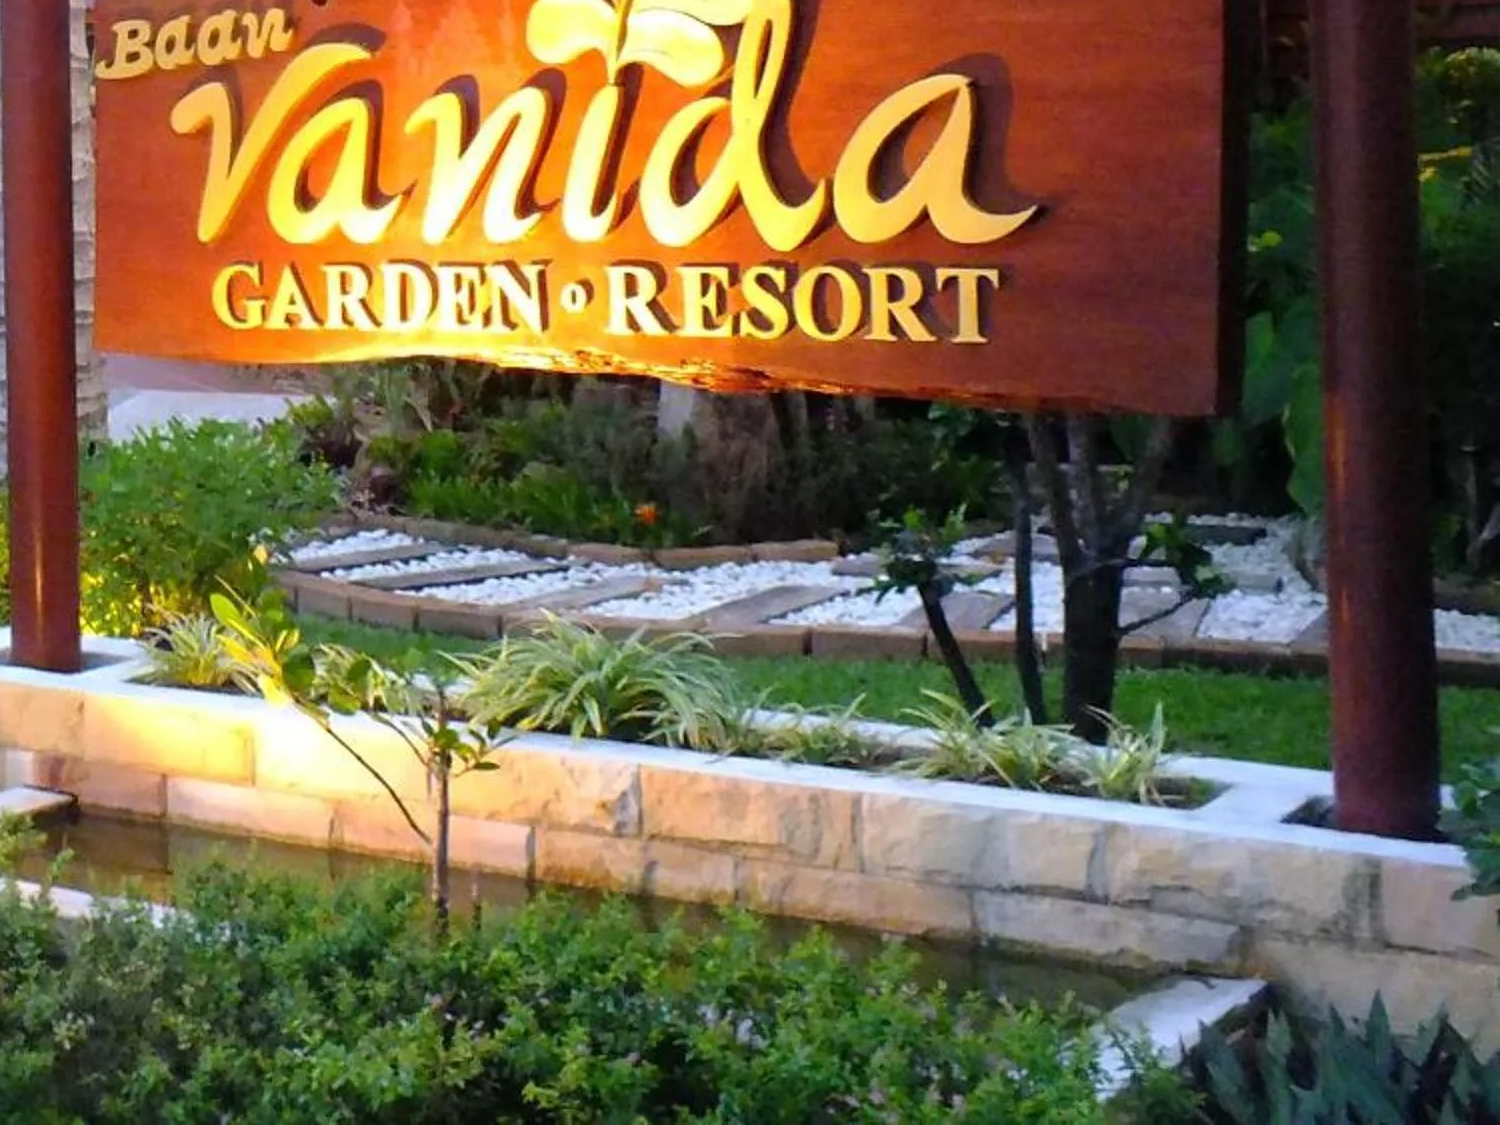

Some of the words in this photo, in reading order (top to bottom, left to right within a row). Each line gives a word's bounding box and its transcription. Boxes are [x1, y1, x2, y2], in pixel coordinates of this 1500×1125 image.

[94, 7, 294, 80] Baan
[211, 261, 552, 335] GARDEN
[602, 264, 999, 345] RESORT
